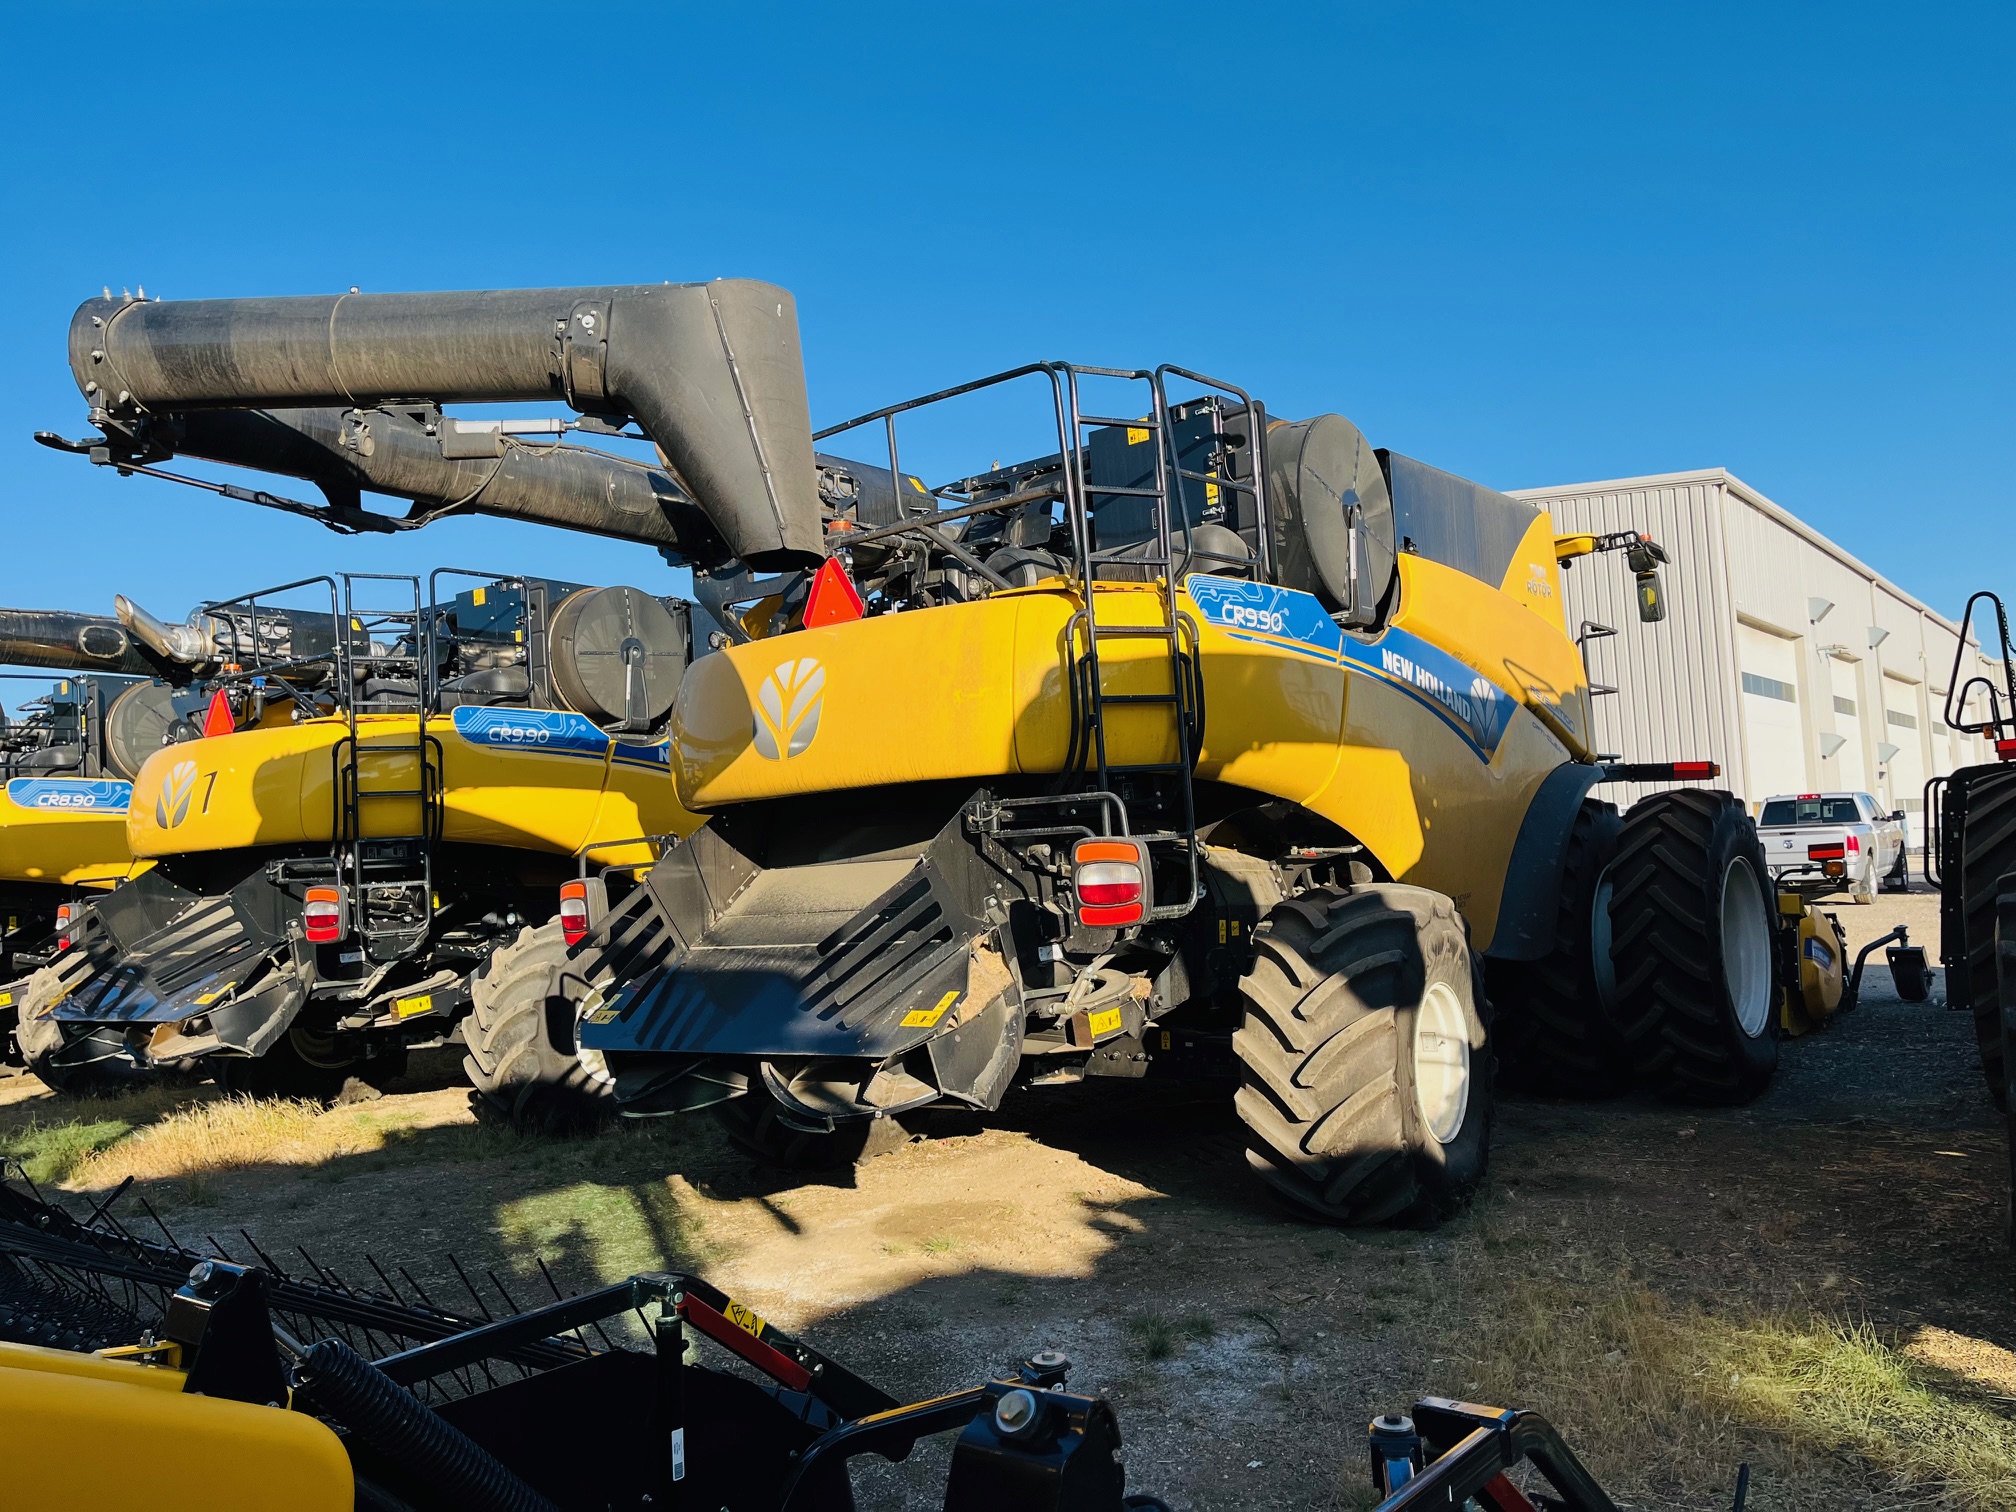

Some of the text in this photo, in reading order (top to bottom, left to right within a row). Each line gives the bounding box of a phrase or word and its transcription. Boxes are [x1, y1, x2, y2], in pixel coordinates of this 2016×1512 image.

[1526, 579, 1552, 598] ROTOR
[1221, 603, 1283, 632] CR9.90
[1381, 647, 1472, 723] NEW HOLLAND
[487, 726, 551, 744] CR9.90
[37, 794, 96, 807] CR8.90
[203, 770, 219, 814] 1
